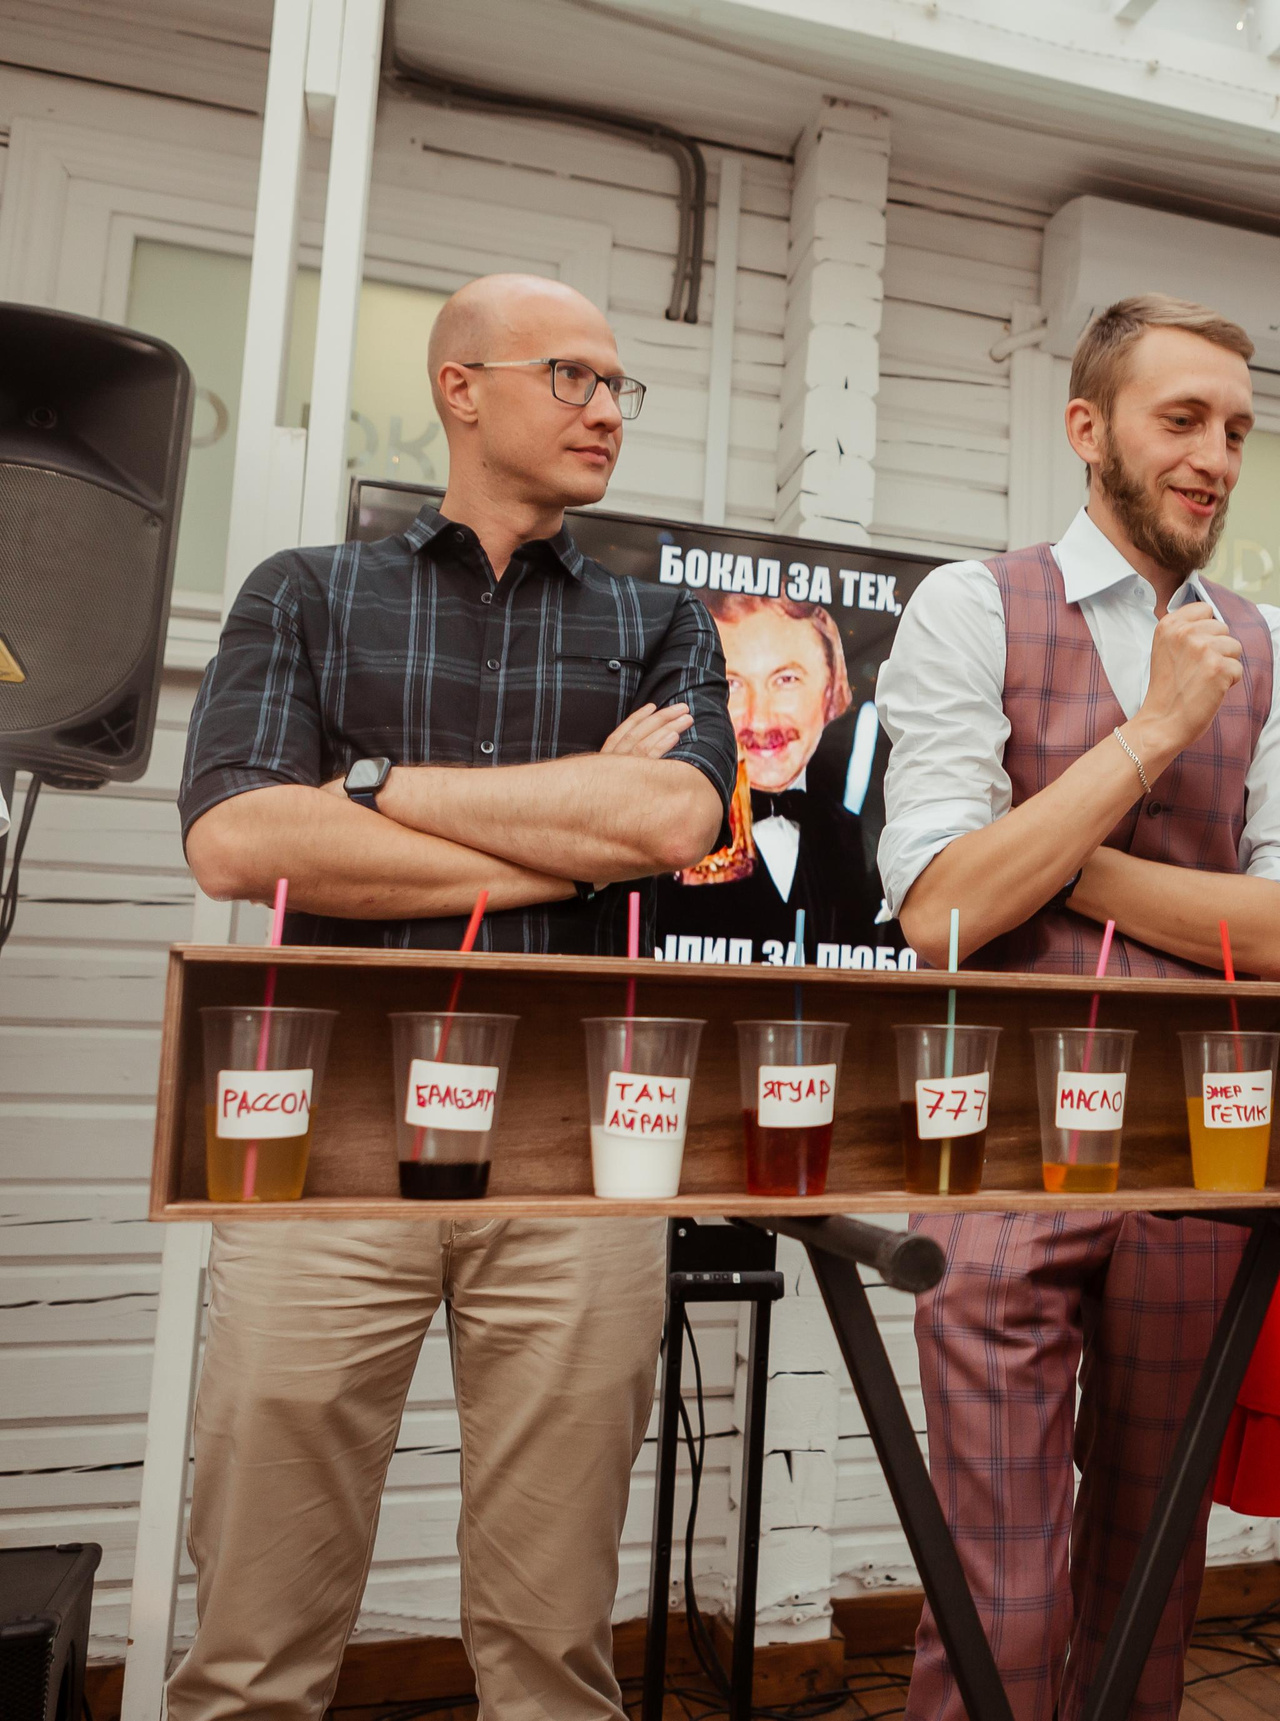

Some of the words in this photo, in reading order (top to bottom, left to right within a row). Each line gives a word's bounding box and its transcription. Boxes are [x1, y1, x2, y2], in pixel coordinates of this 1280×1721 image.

[659, 543, 781, 598] БОКАЛ
[786, 562, 833, 605] ЗА
[839, 568, 903, 617] ТЕХ,
[761, 939, 806, 968] ЗА
[615, 1082, 677, 1104] ТАН
[762, 1078, 832, 1104] ЯГУАР
[922, 1086, 987, 1122] 777
[1060, 1088, 1123, 1113] МАСЛО
[608, 1108, 679, 1134] АЙРАН
[1210, 1104, 1268, 1123] ГЕТИК
